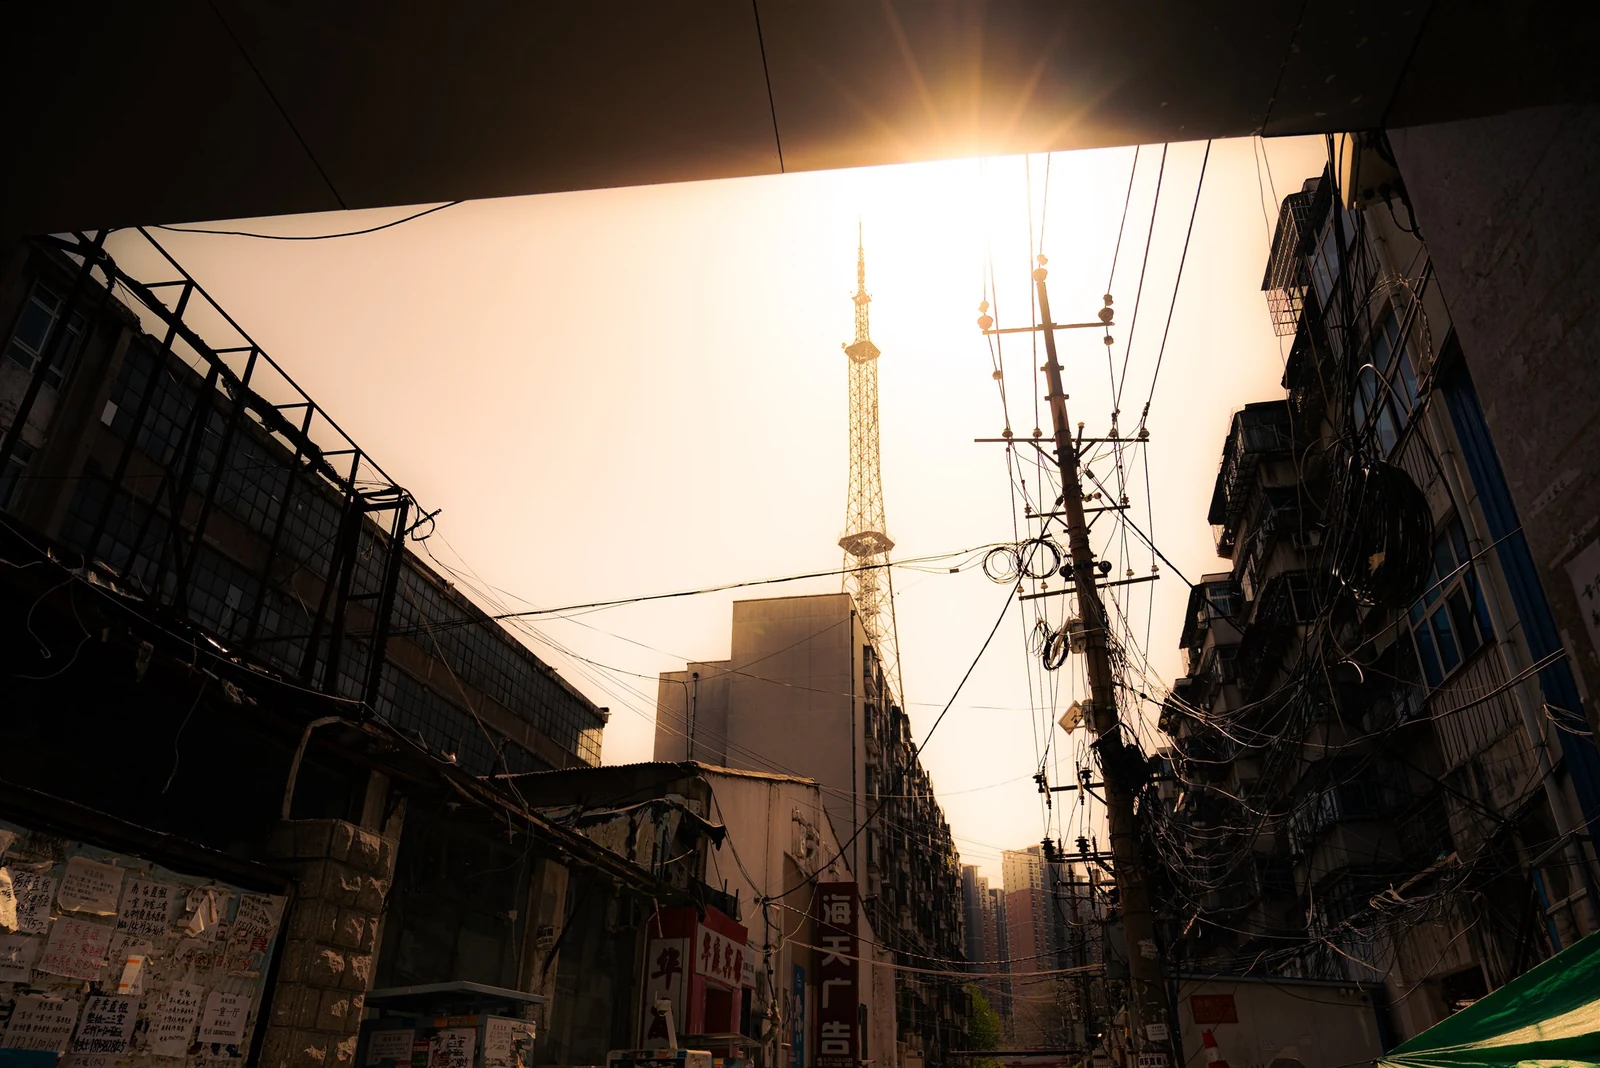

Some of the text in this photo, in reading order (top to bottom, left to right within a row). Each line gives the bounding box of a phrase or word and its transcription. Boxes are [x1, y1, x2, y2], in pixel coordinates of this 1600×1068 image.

[211, 1006, 241, 1018] 一室一厅
[821, 893, 852, 1055] 海天广告
